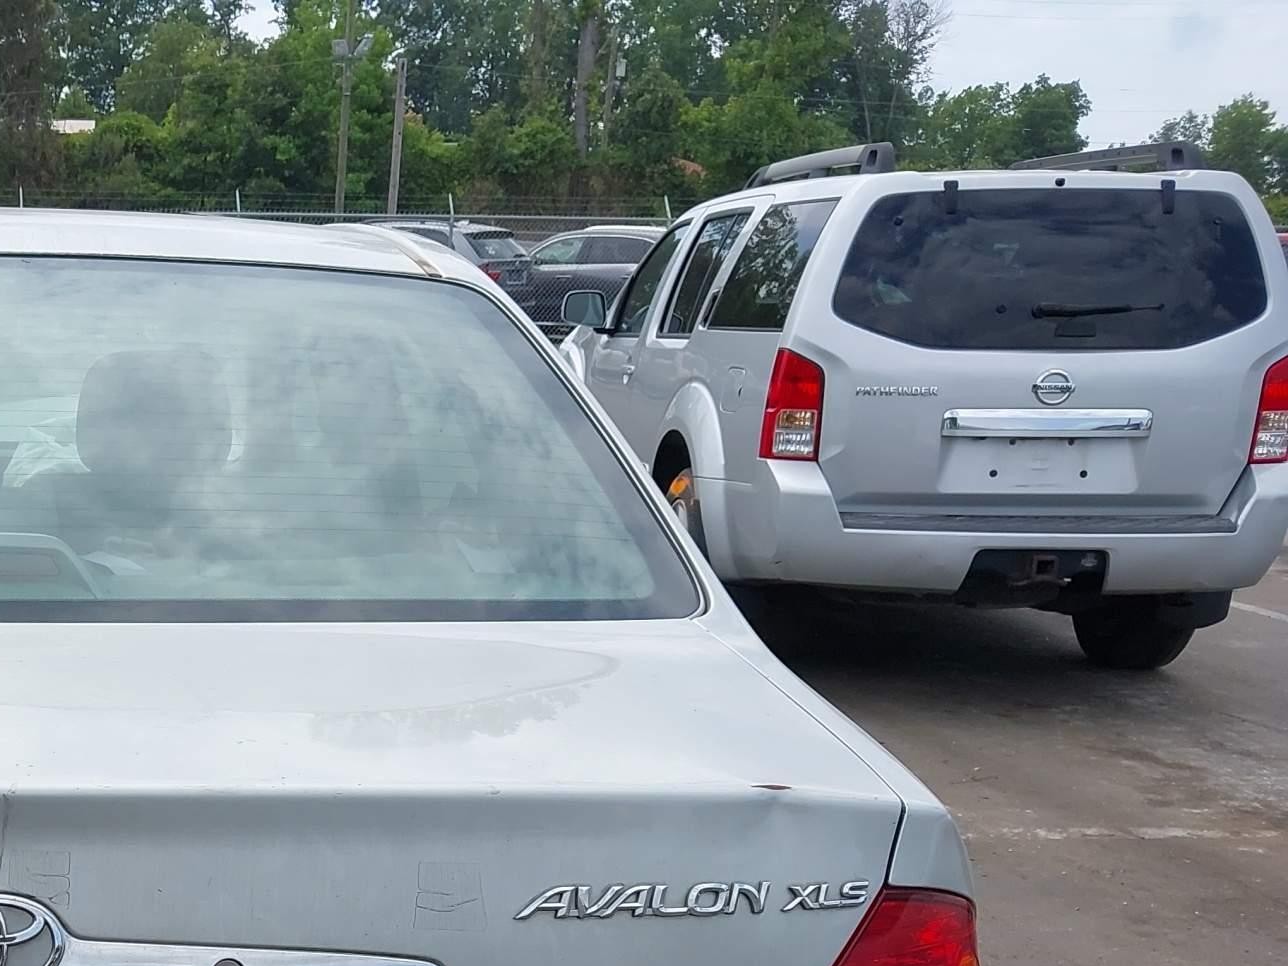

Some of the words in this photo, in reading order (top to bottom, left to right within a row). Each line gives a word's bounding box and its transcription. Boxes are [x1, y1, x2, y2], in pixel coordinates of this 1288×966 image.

[855, 385, 939, 397] PATHFINDER
[513, 881, 771, 922] AVALON
[781, 880, 870, 913] XLS
